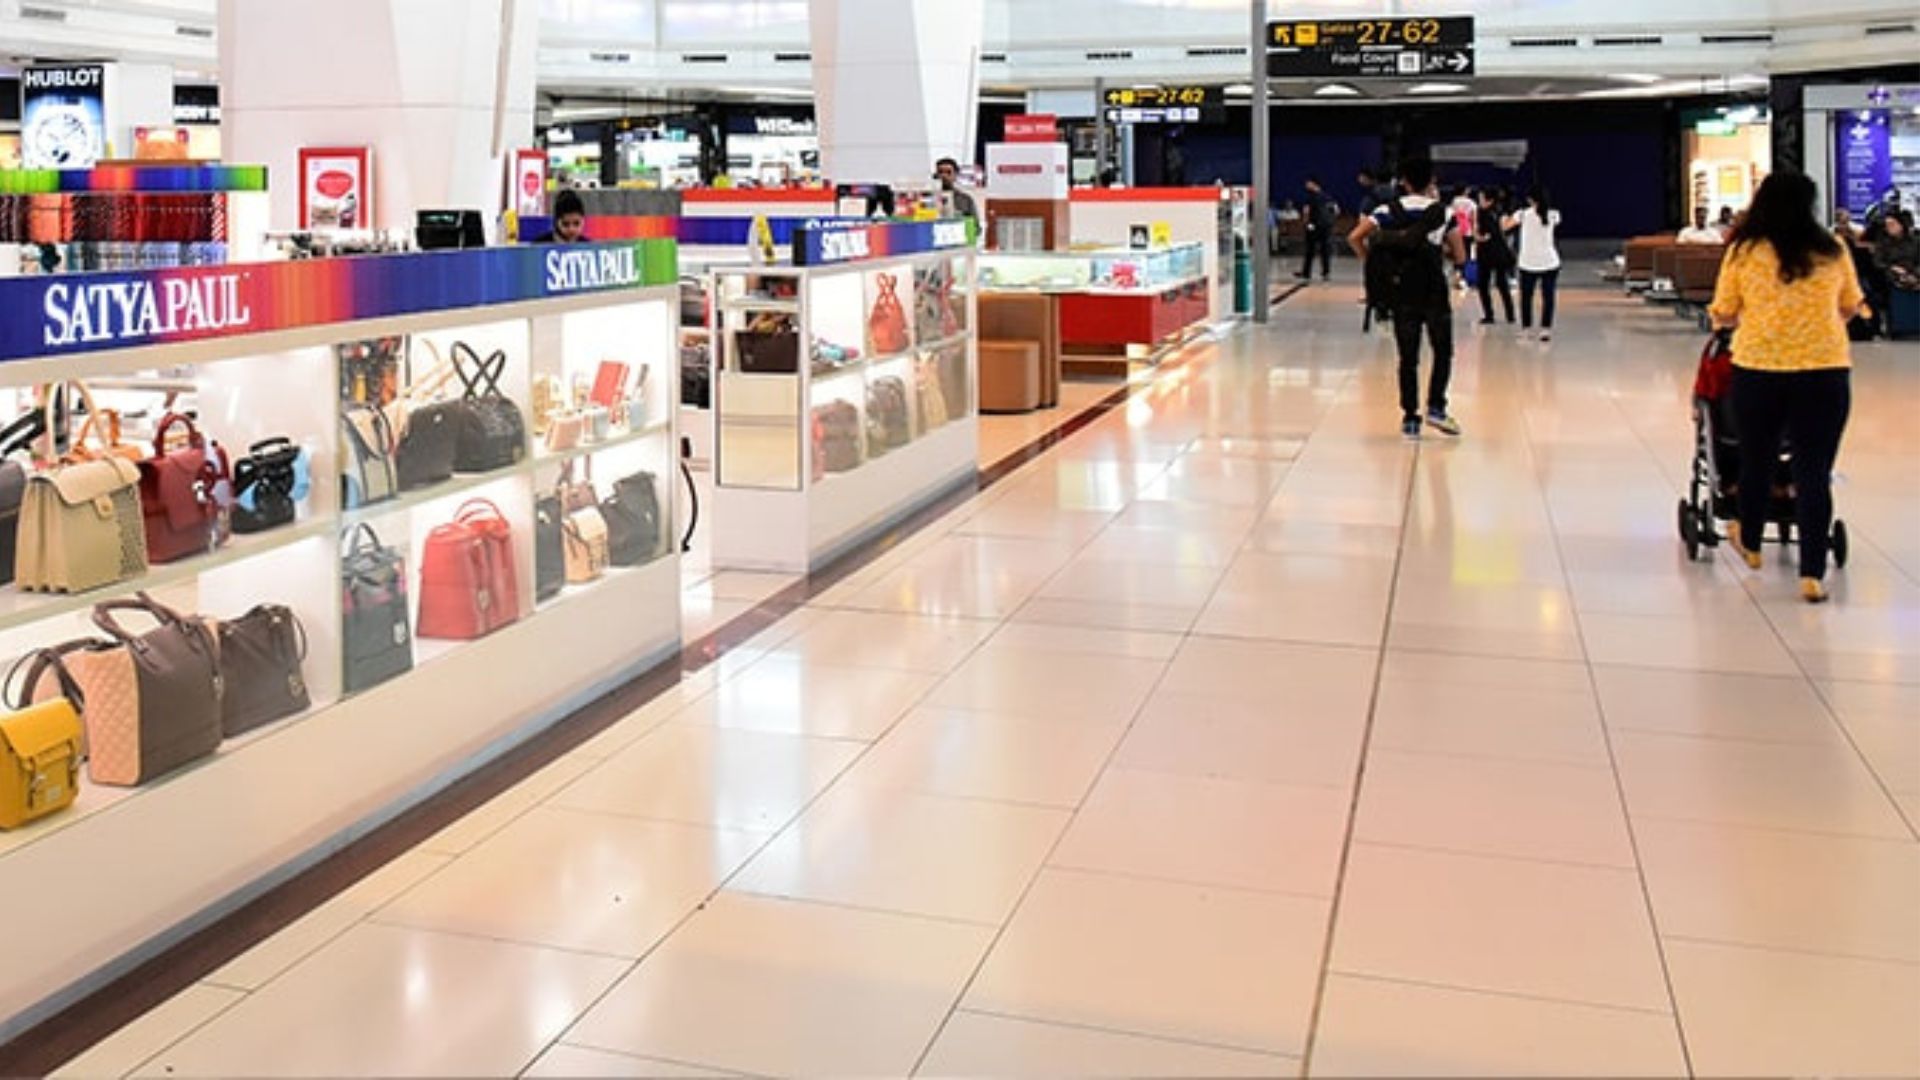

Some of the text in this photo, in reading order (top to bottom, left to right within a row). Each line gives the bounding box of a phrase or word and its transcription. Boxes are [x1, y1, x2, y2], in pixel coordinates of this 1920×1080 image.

[1357, 19, 1441, 44] 27-62
[1331, 52, 1396, 65] Food Court
[26, 68, 101, 87] HUBLOT
[43, 273, 250, 345] SATYA PAUL
